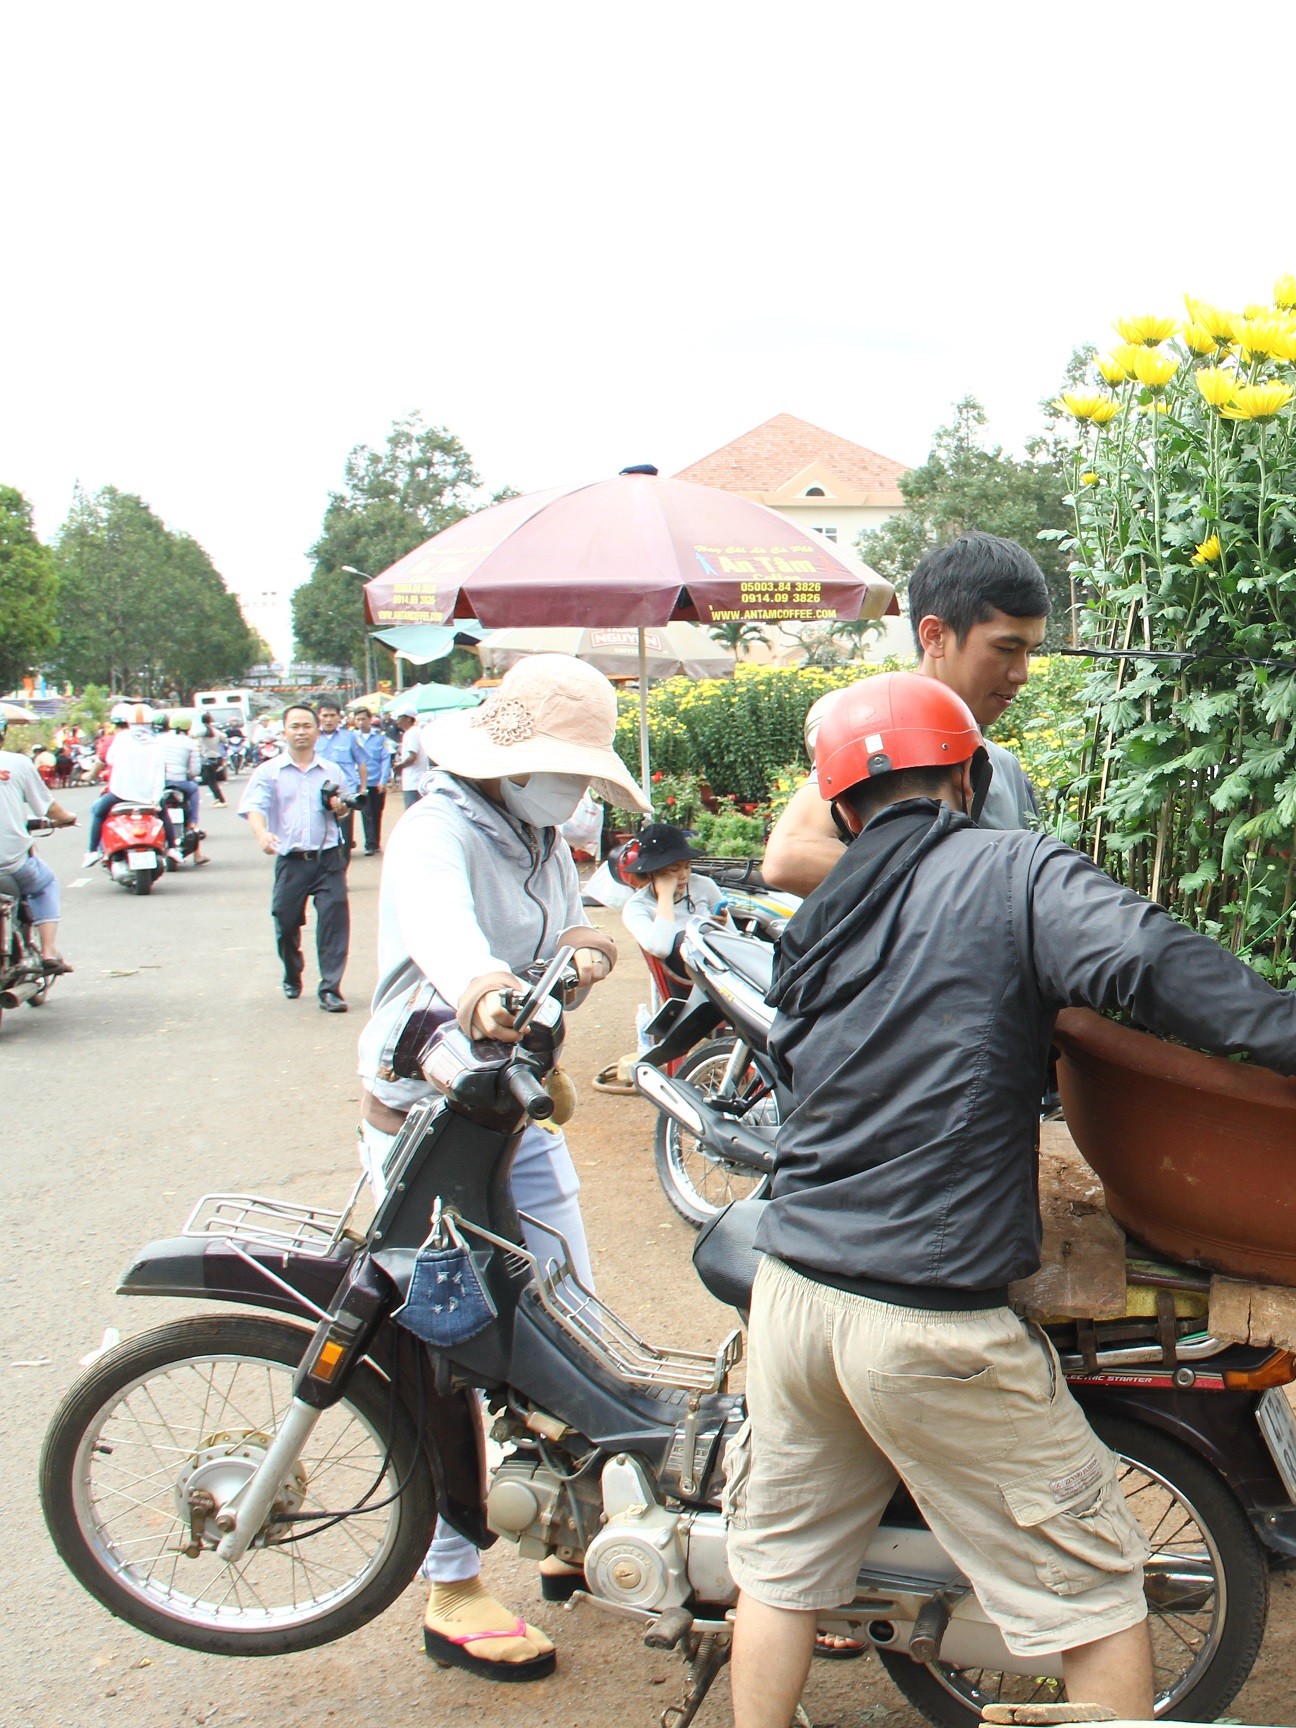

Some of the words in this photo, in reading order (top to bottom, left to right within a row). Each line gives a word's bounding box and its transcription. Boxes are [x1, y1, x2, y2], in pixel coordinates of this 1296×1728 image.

[719, 557, 755, 573] An
[754, 557, 817, 573] Tâm
[740, 582, 791, 592] 05003.84
[795, 582, 821, 592] 3826
[741, 593, 789, 603] 0914.09
[792, 593, 821, 603] 3826
[712, 609, 836, 620] WWW.ANTAMCOFFEE.COM
[595, 633, 658, 645] NGUYN
